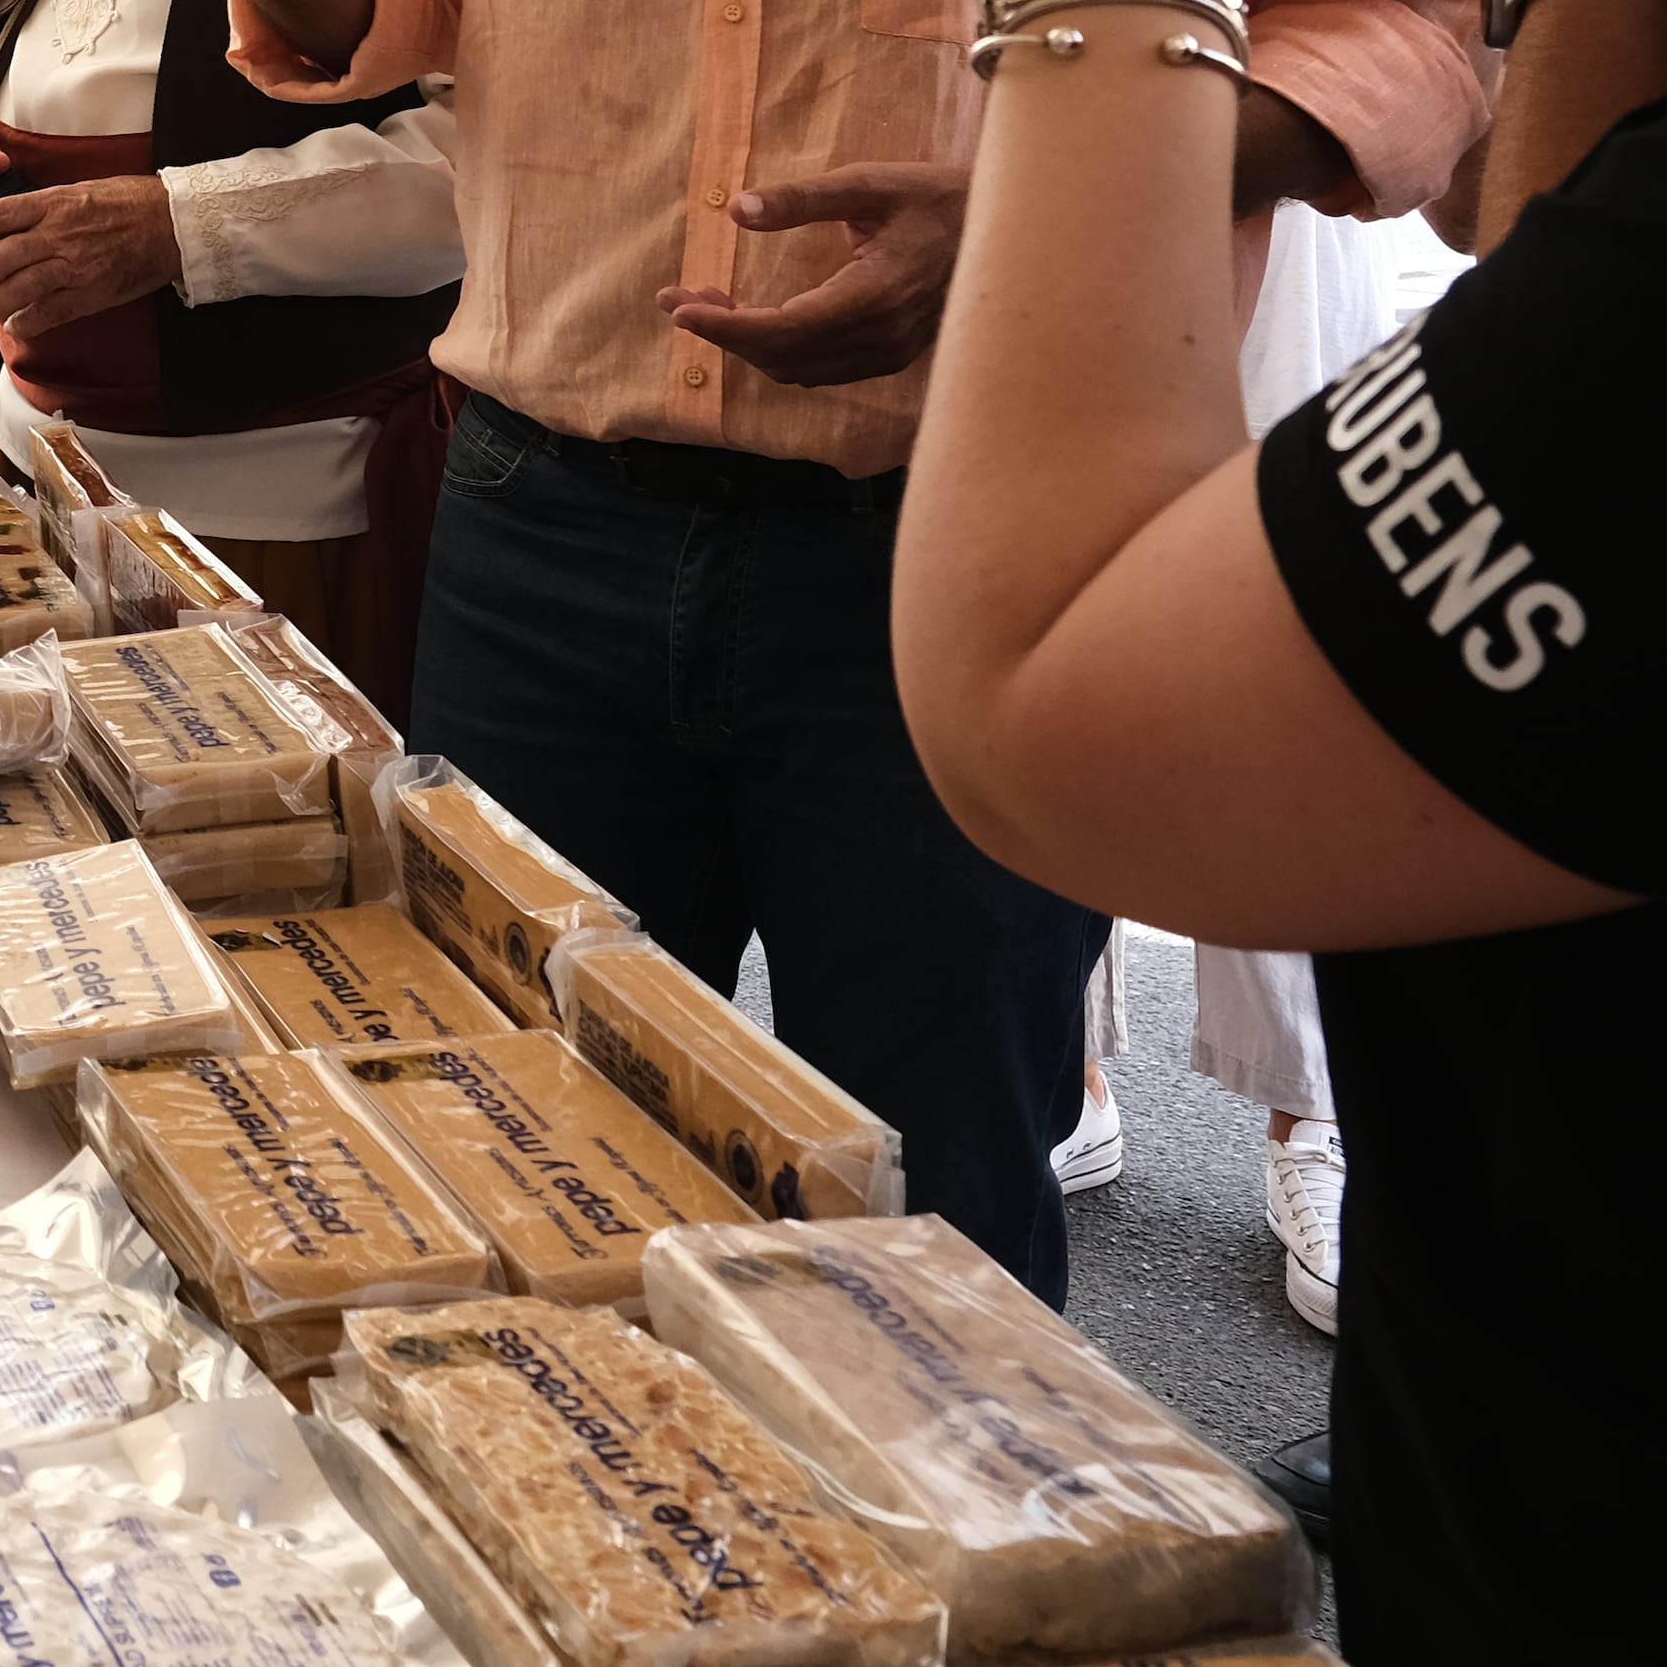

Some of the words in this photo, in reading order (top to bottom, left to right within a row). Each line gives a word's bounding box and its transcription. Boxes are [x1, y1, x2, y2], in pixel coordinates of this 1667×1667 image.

[113, 645, 184, 705] mercedes
[178, 714, 230, 751] pepe
[71, 961, 126, 1009] pepe
[270, 916, 365, 1005] mercedes
[427, 1046, 551, 1156] mercedes
[528, 1157, 579, 1174] y
[286, 1169, 363, 1239] pepe
[553, 1174, 642, 1238] pepe
[477, 1320, 639, 1472] mercedes
[647, 1500, 764, 1592] pepe
